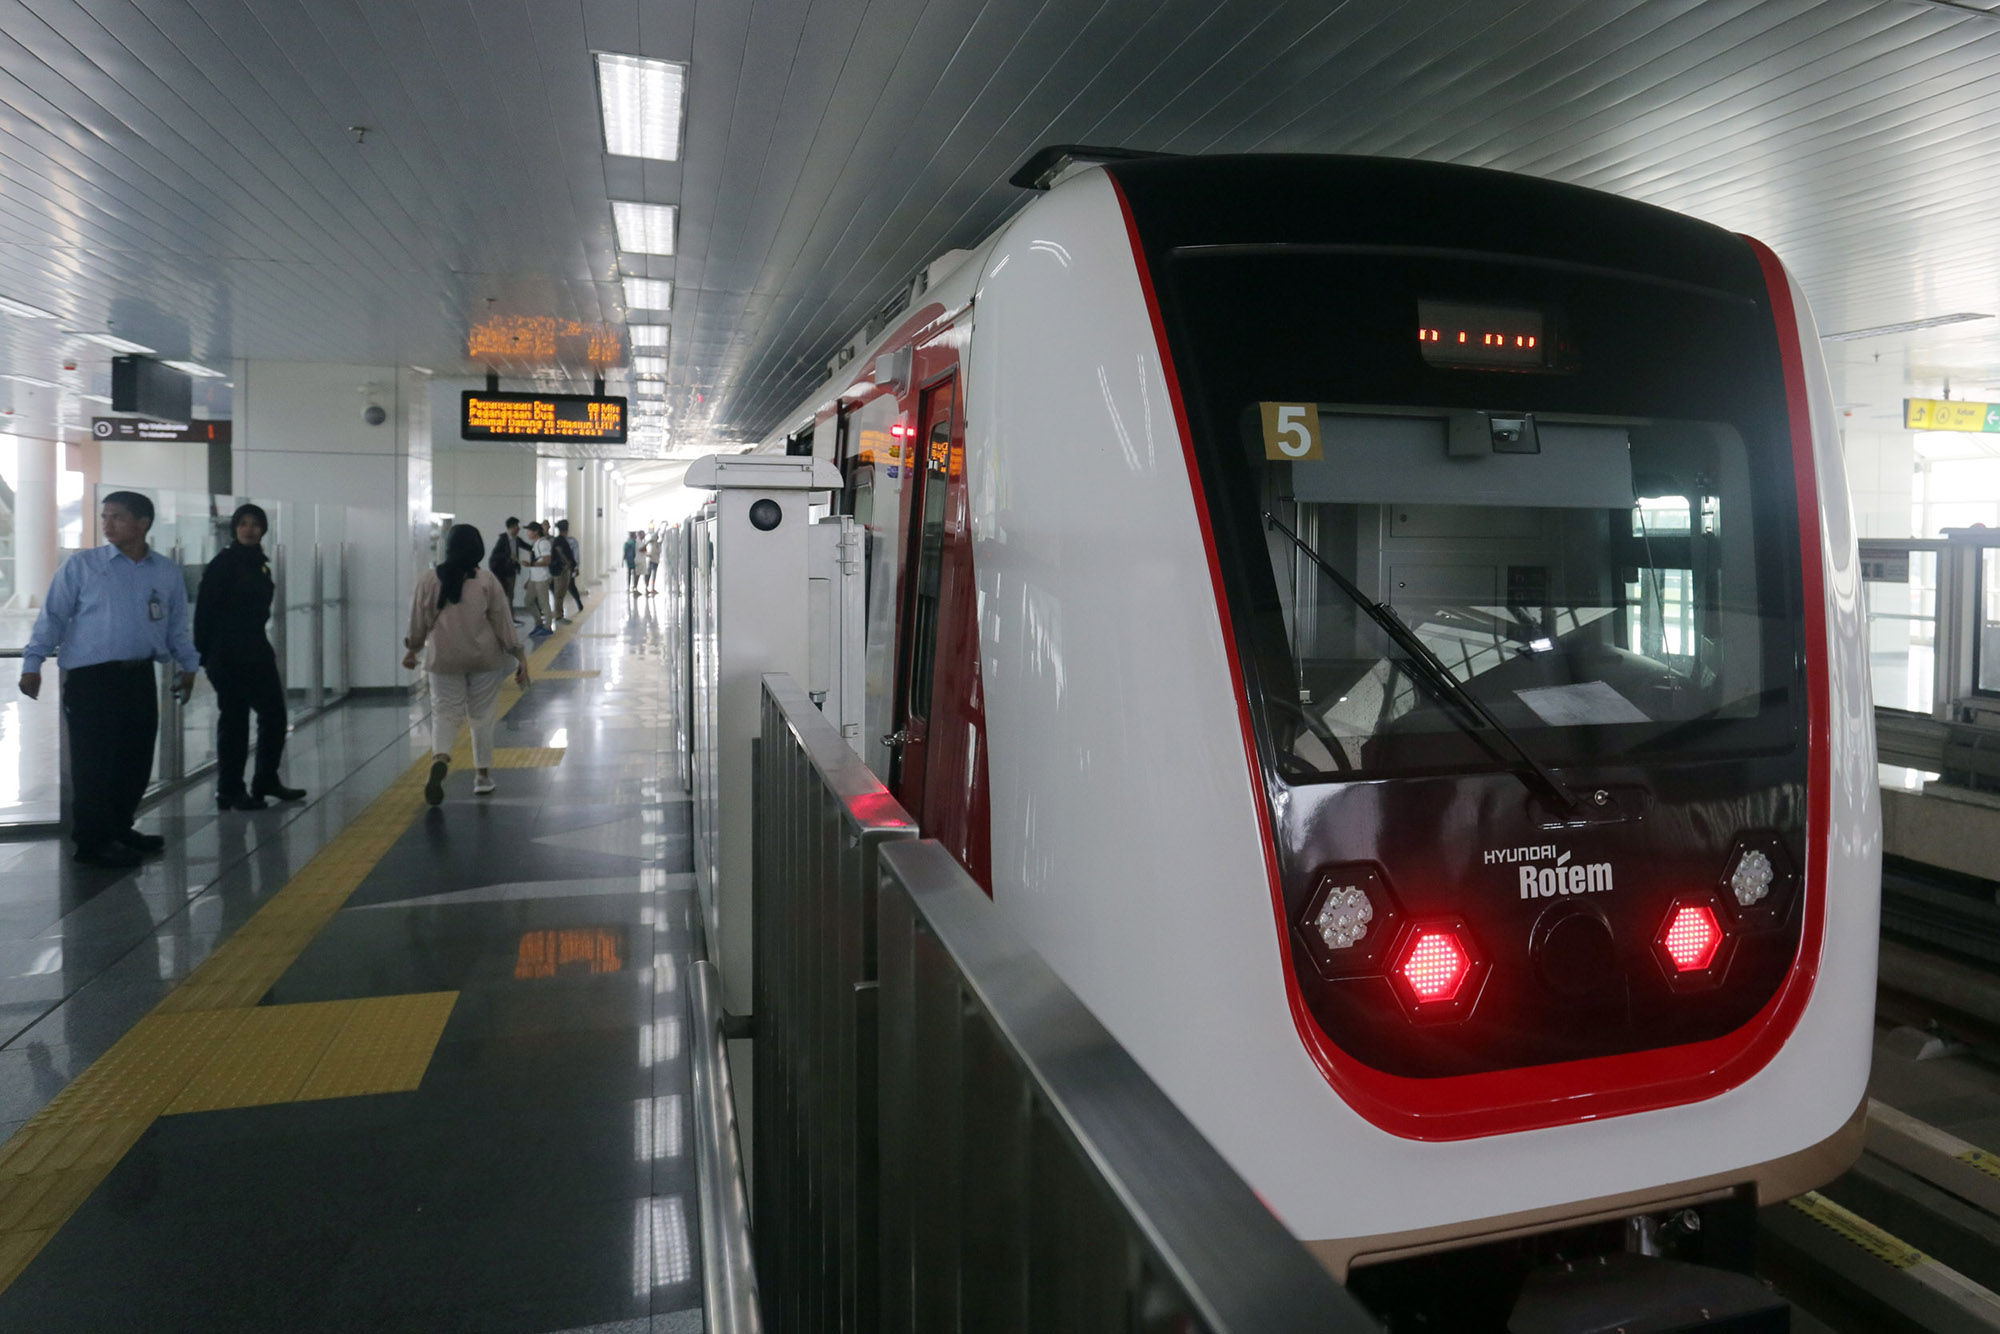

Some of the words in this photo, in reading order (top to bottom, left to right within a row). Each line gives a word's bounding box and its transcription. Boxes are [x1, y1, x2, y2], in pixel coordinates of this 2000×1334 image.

[1277, 406, 1311, 457] 5
[1484, 845, 1557, 864] HYUNDAI
[1519, 851, 1613, 899] Rotem
